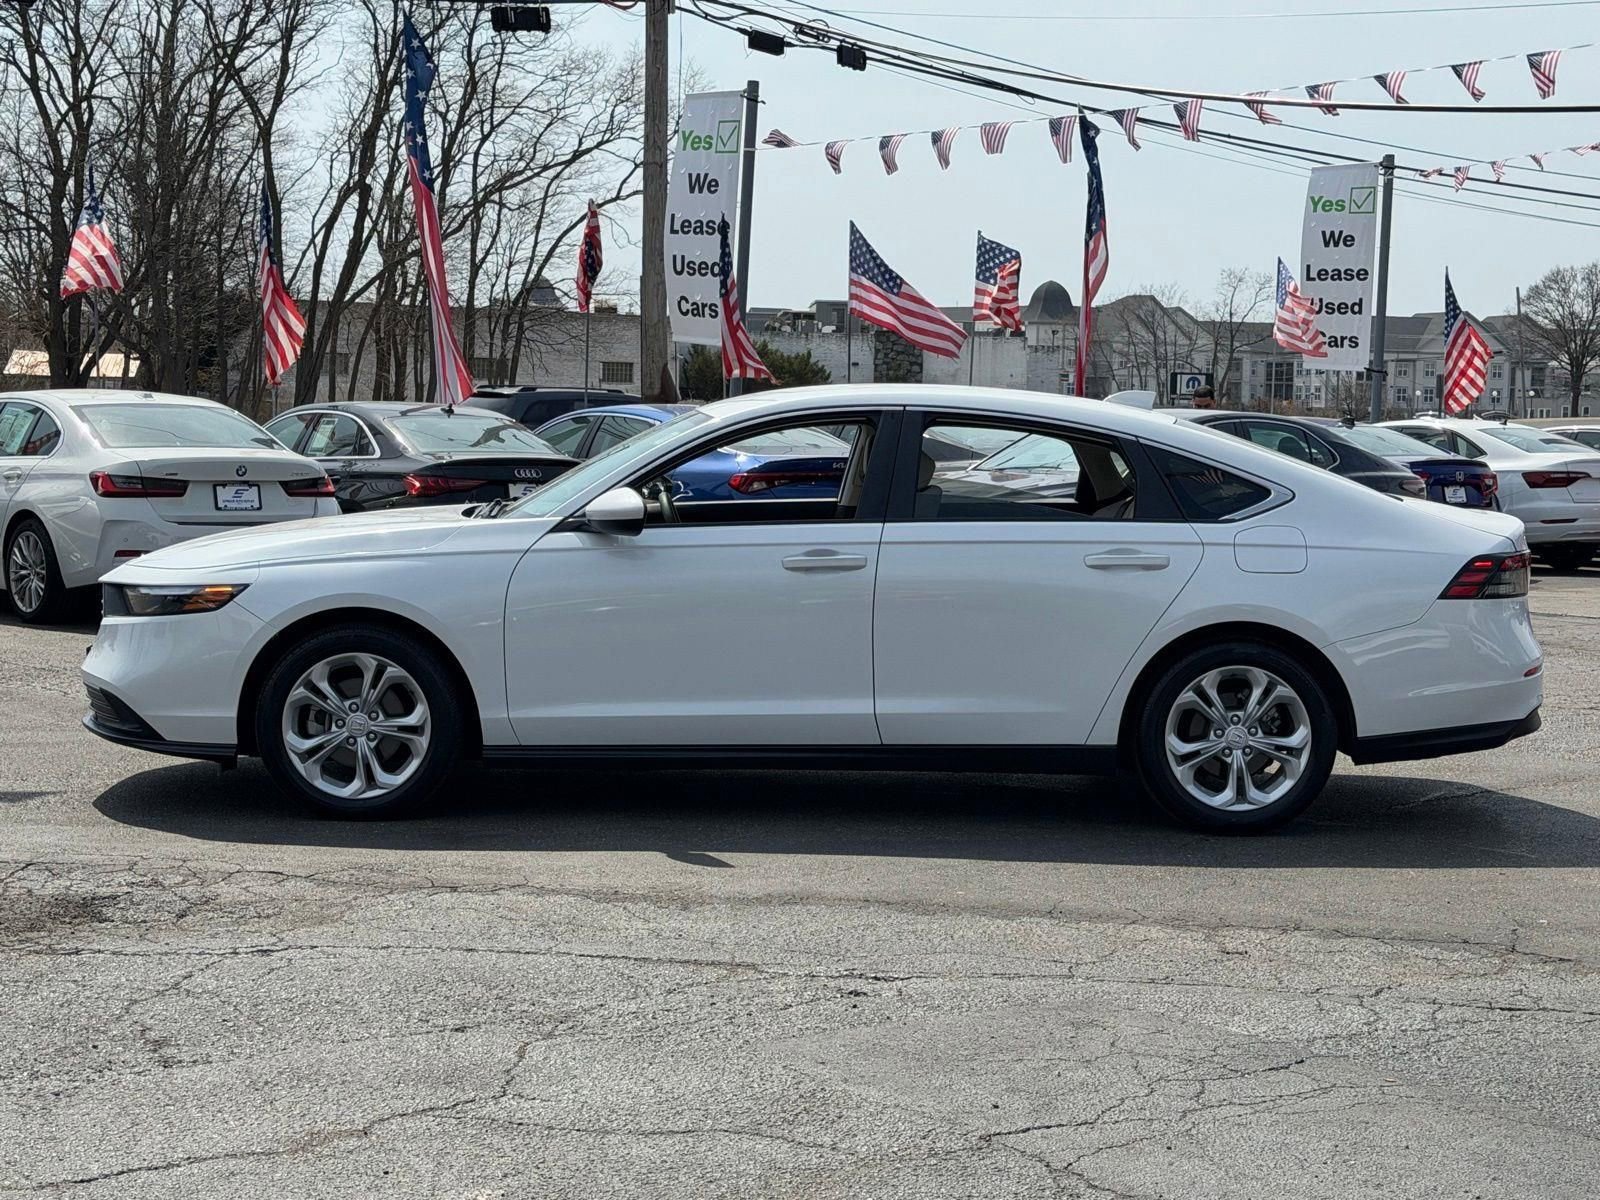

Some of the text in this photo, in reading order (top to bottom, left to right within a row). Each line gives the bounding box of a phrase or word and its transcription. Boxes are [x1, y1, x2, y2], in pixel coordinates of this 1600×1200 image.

[681, 129, 714, 151] Yes
[687, 172, 720, 195] We
[1309, 196, 1346, 213] Yes
[669, 213, 731, 236] Lease
[1321, 230, 1356, 248] We
[1305, 264, 1369, 282] Lease
[677, 295, 719, 319] Cars
[1310, 297, 1363, 315] Used
